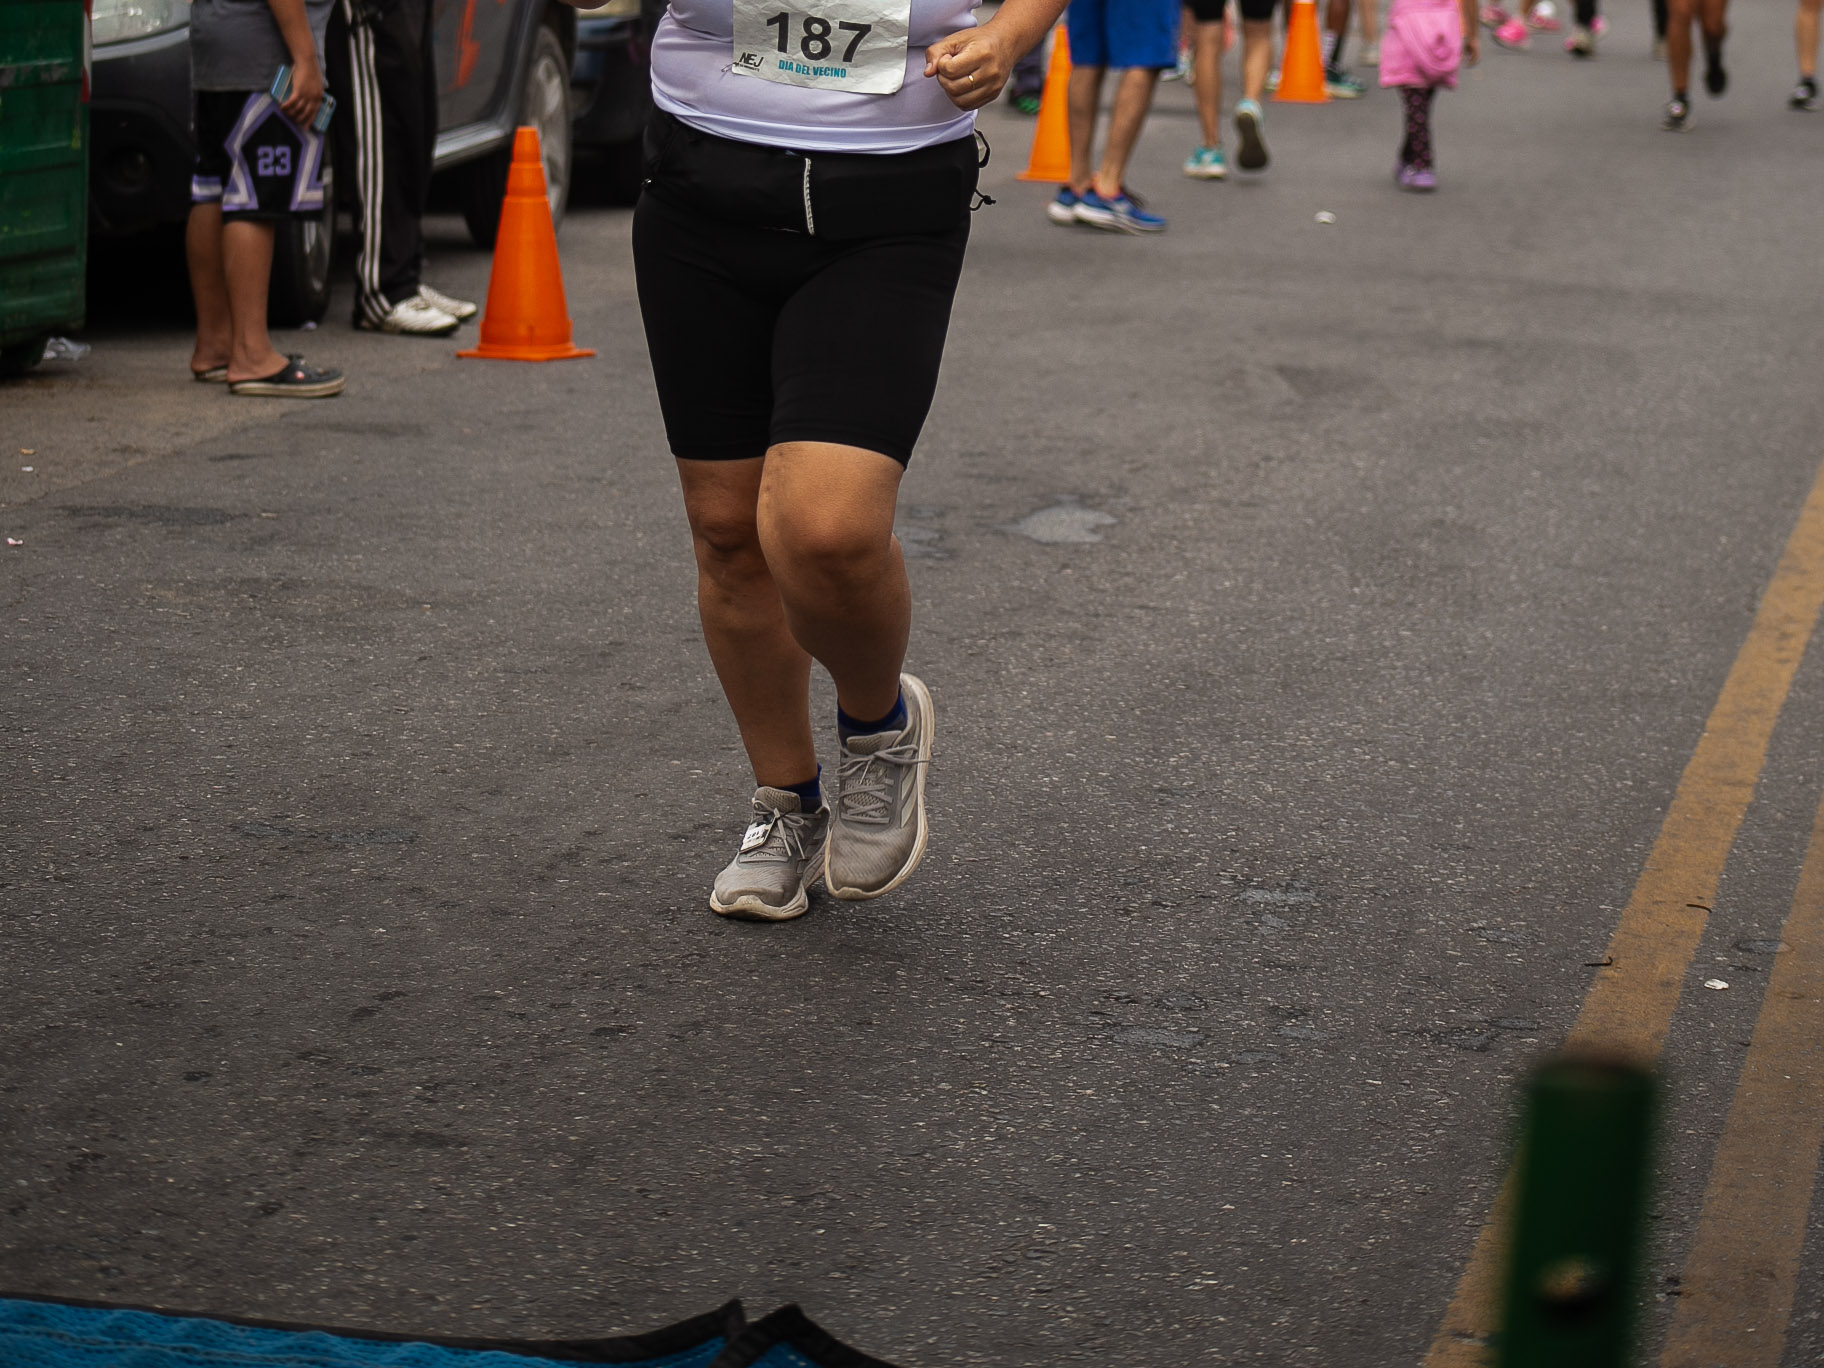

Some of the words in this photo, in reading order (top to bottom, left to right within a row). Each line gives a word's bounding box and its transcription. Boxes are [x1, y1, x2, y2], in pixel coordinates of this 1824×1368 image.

[766, 11, 872, 63] 187
[739, 51, 765, 68] NEJ
[778, 59, 794, 72] DIA
[795, 63, 811, 76] DEL
[812, 66, 847, 78] VECINO
[257, 145, 291, 177] 23
